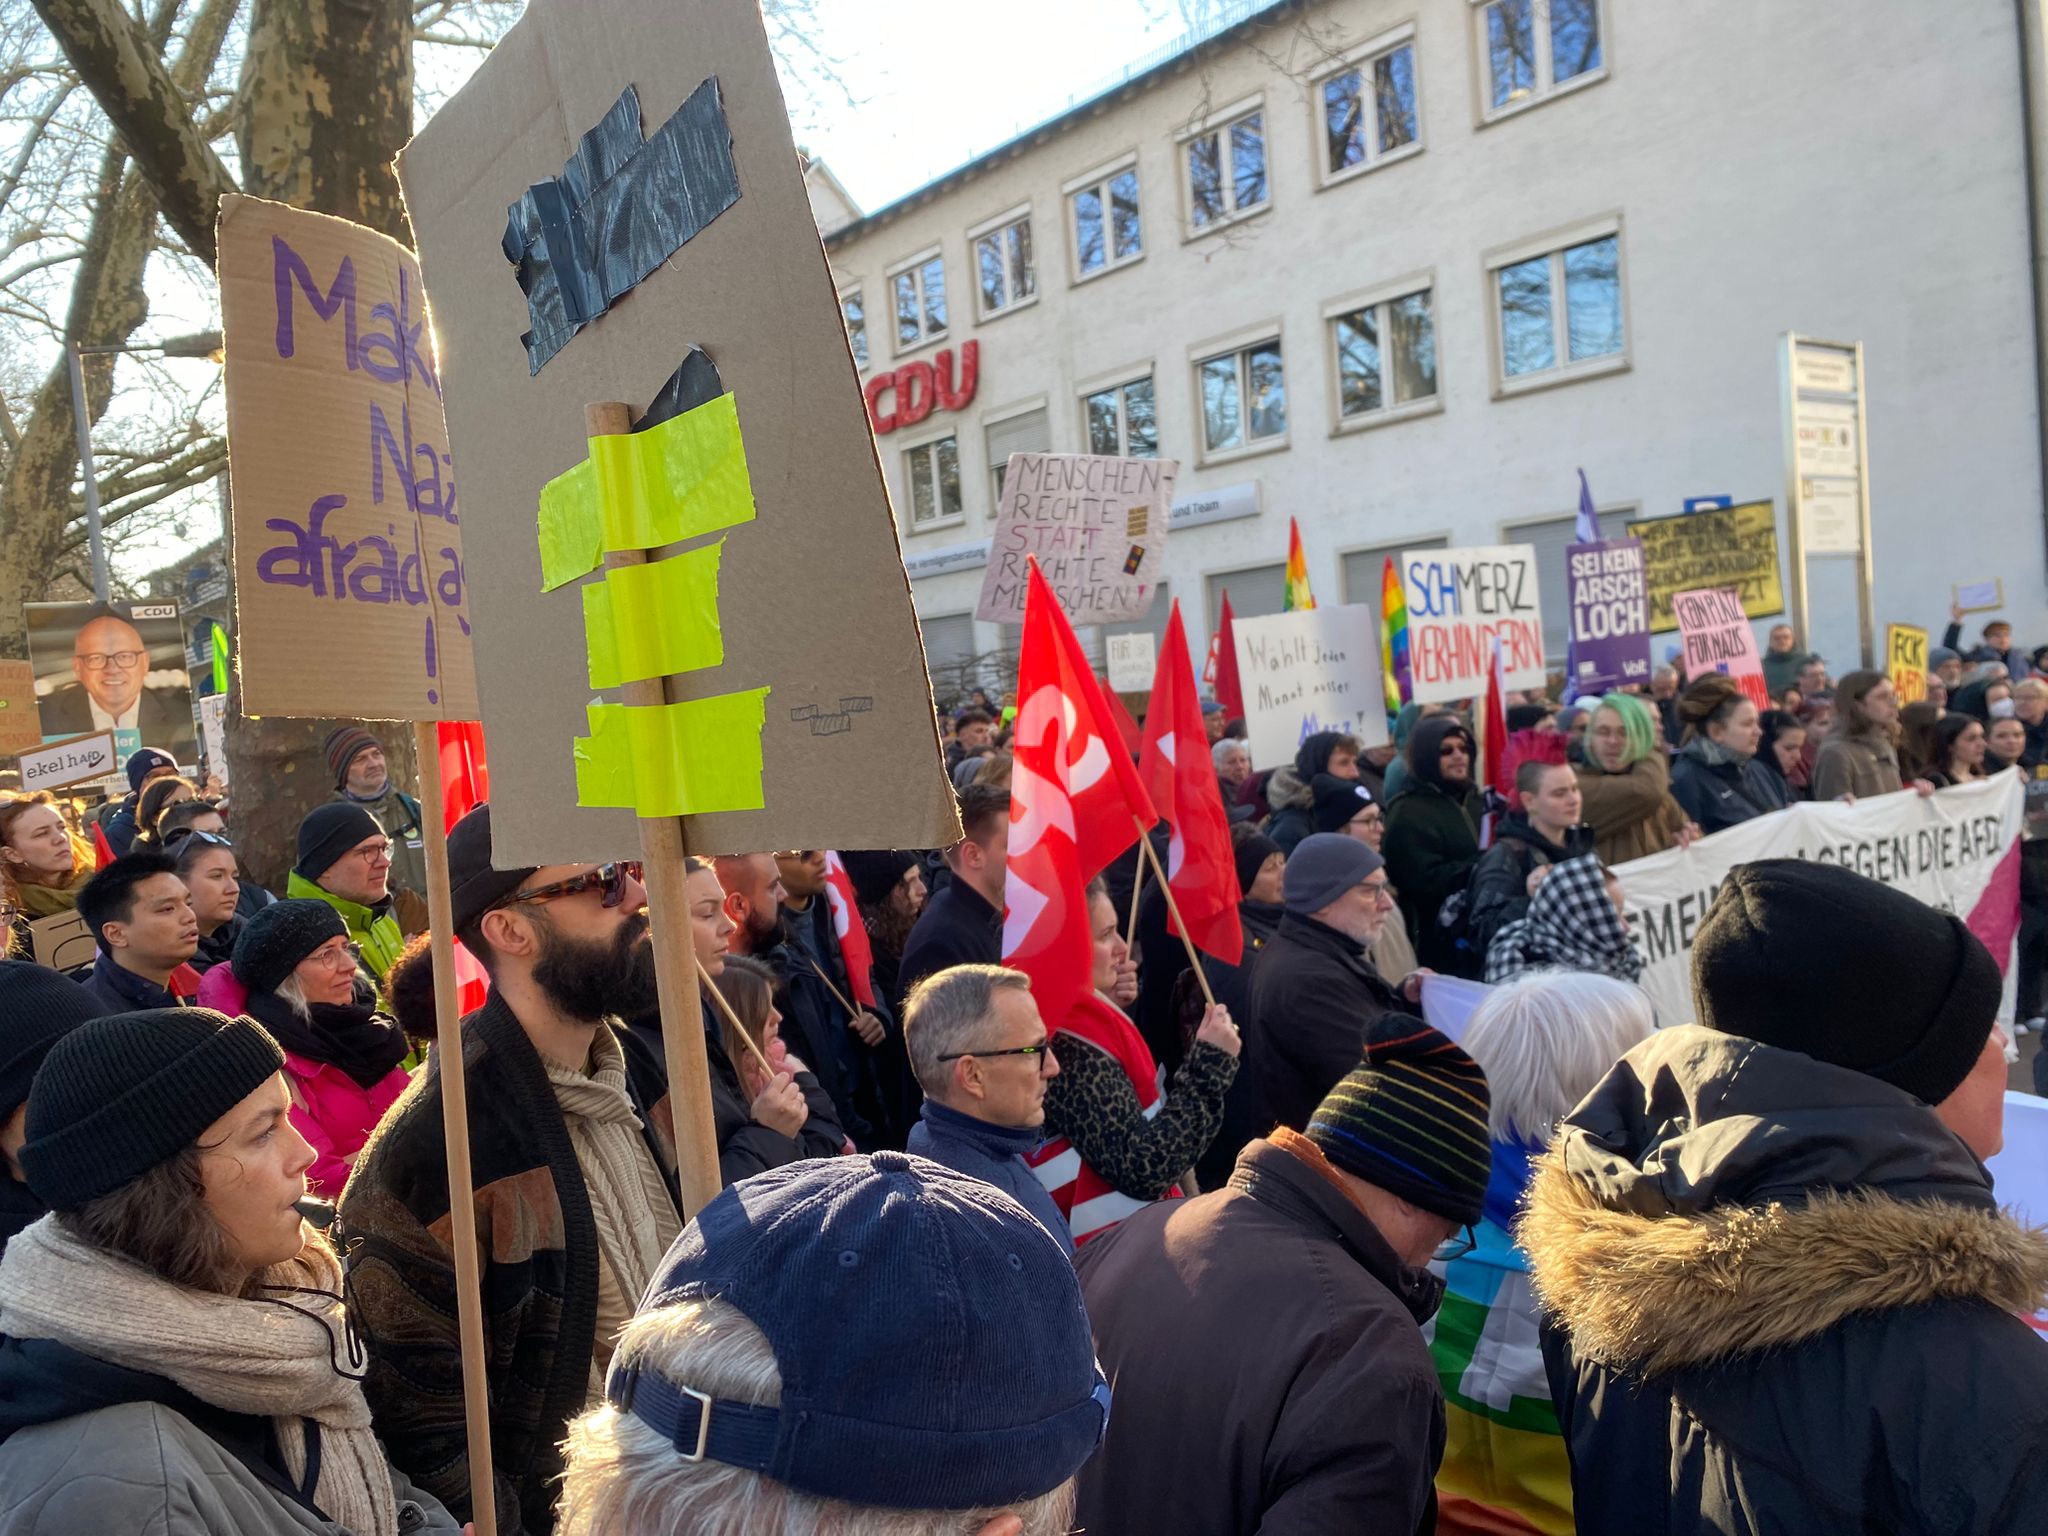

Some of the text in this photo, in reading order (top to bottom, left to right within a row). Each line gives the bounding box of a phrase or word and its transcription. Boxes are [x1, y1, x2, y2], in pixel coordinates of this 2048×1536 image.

[272, 234, 442, 401] Mak
[864, 339, 979, 435] CDU
[1015, 457, 1173, 494] MENSCHEN-
[1012, 493, 1118, 524] RECHTE
[1192, 501, 1220, 515] Team
[1004, 525, 1104, 552] STATT
[256, 494, 471, 636] afraid a
[999, 552, 1106, 583] RECHTE
[1570, 546, 1642, 579] SEI KEIN
[991, 583, 1147, 612] MESCHEN!
[1408, 560, 1535, 617] SCHMERZ
[1573, 572, 1644, 606] ARSCH
[143, 605, 174, 618] CDU
[1575, 599, 1648, 642] LOCH
[1710, 627, 1747, 660] NAZIS
[26, 756, 65, 780] ekel
[1916, 825, 1956, 873] DIE
